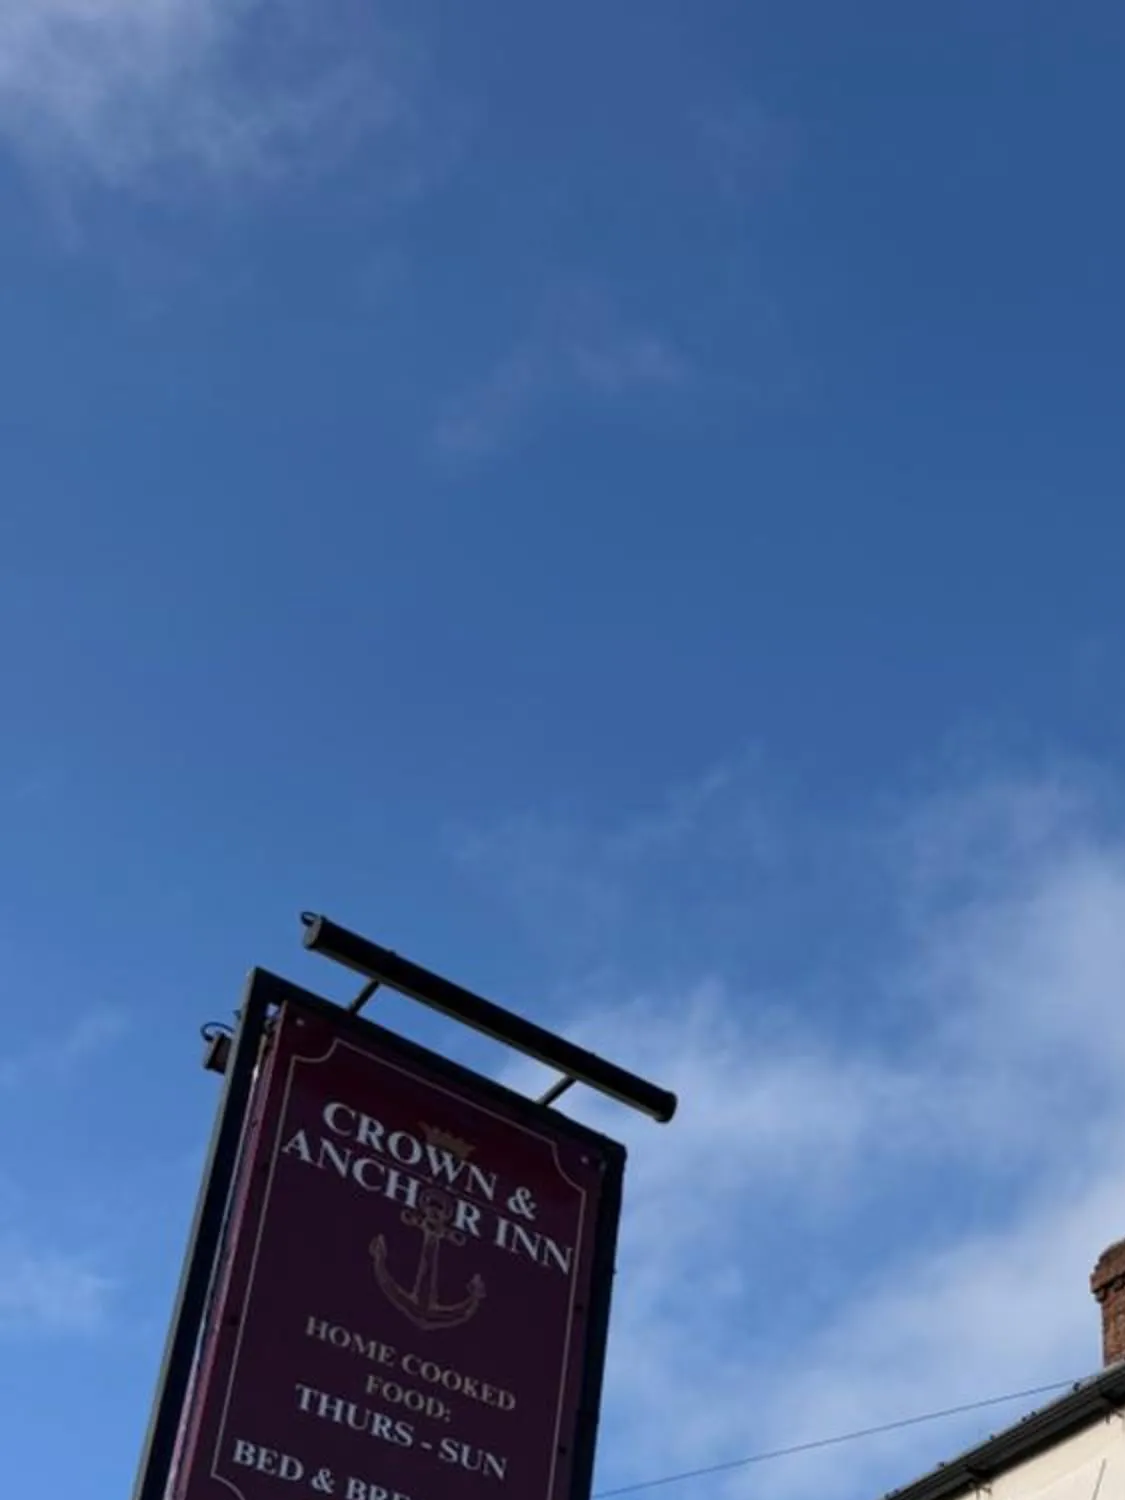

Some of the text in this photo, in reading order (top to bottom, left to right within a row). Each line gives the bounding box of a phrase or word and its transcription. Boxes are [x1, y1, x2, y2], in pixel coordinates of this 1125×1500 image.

[323, 1102, 538, 1220] CROWN &
[495, 1217, 573, 1275] INN
[304, 1316, 516, 1411] HOME COOKED
[365, 1374, 452, 1422] FOOD:
[232, 1438, 304, 1482] BED
[311, 1468, 336, 1493] &
[295, 1383, 415, 1448] THURS
[438, 1438, 507, 1480] SUN
